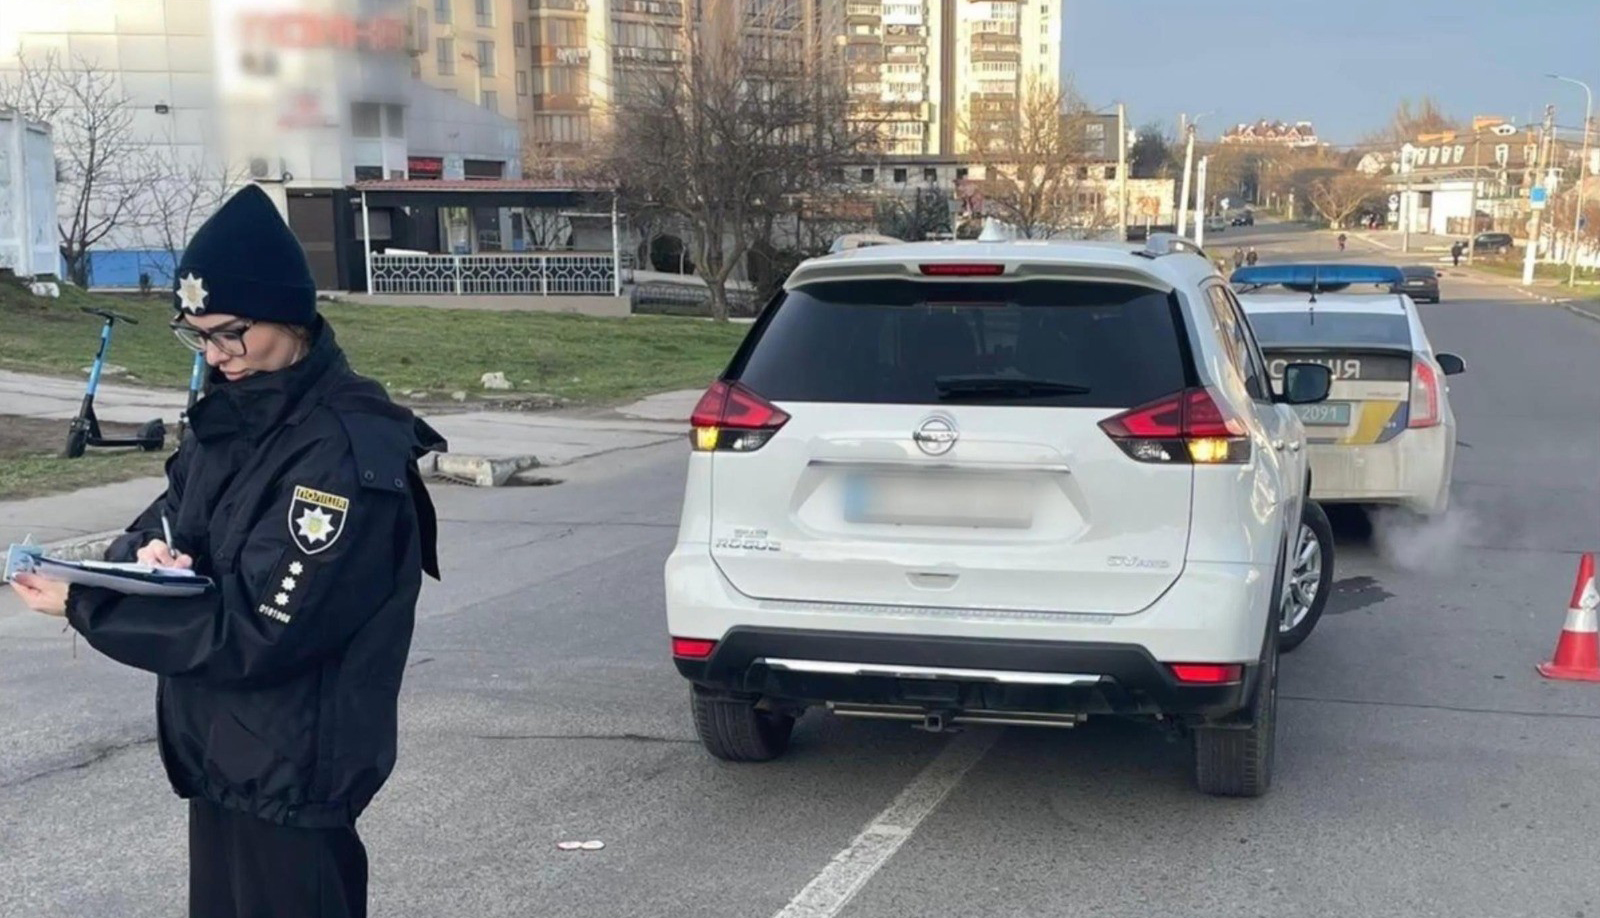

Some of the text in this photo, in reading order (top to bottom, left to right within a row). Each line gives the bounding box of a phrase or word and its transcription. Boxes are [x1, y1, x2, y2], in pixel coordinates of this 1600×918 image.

[1302, 405, 1337, 421] 2091
[296, 488, 347, 510] ПОЛІЦІЯ
[716, 539, 782, 552] ROGUE
